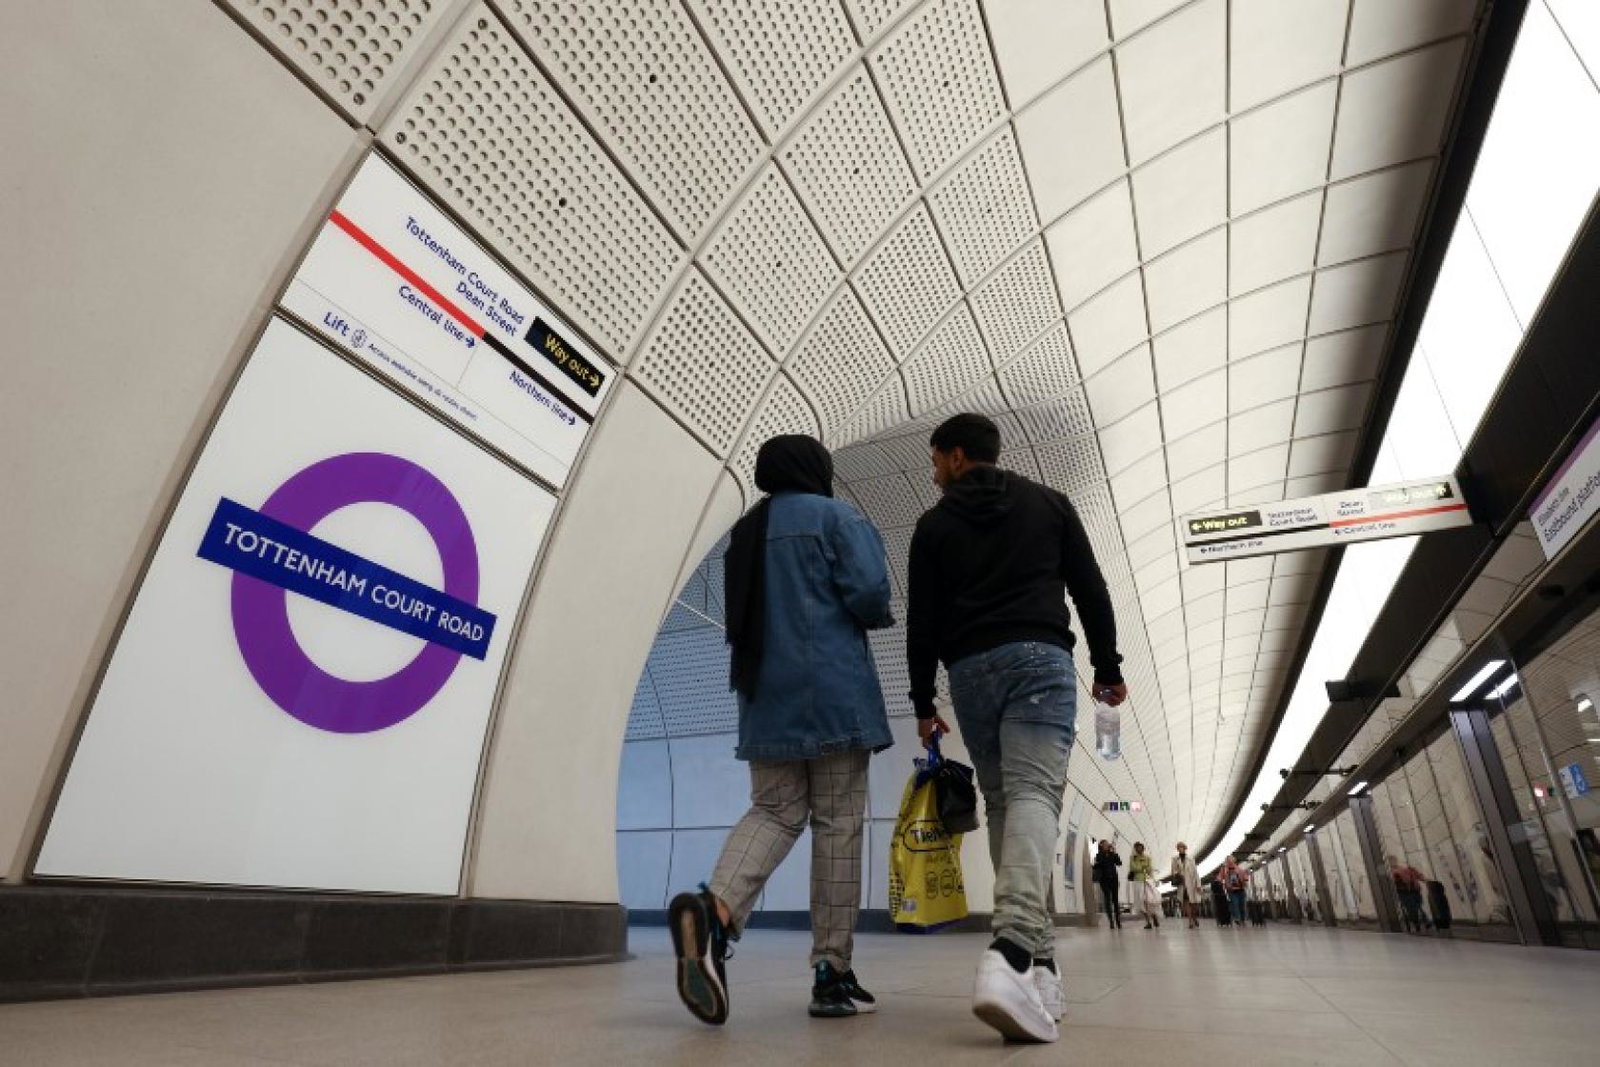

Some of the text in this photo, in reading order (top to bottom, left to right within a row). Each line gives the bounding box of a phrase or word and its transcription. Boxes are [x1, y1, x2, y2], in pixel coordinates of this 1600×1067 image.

[406, 215, 525, 325] Tottenham Court Road
[323, 311, 350, 337] Lift
[398, 285, 465, 341] Central line
[456, 281, 517, 337] Dean Street
[544, 333, 589, 380] Way out
[509, 370, 568, 422] Northern line
[1202, 517, 1248, 530] Way out
[225, 523, 484, 641] TOTTENHAM COURT ROAD
